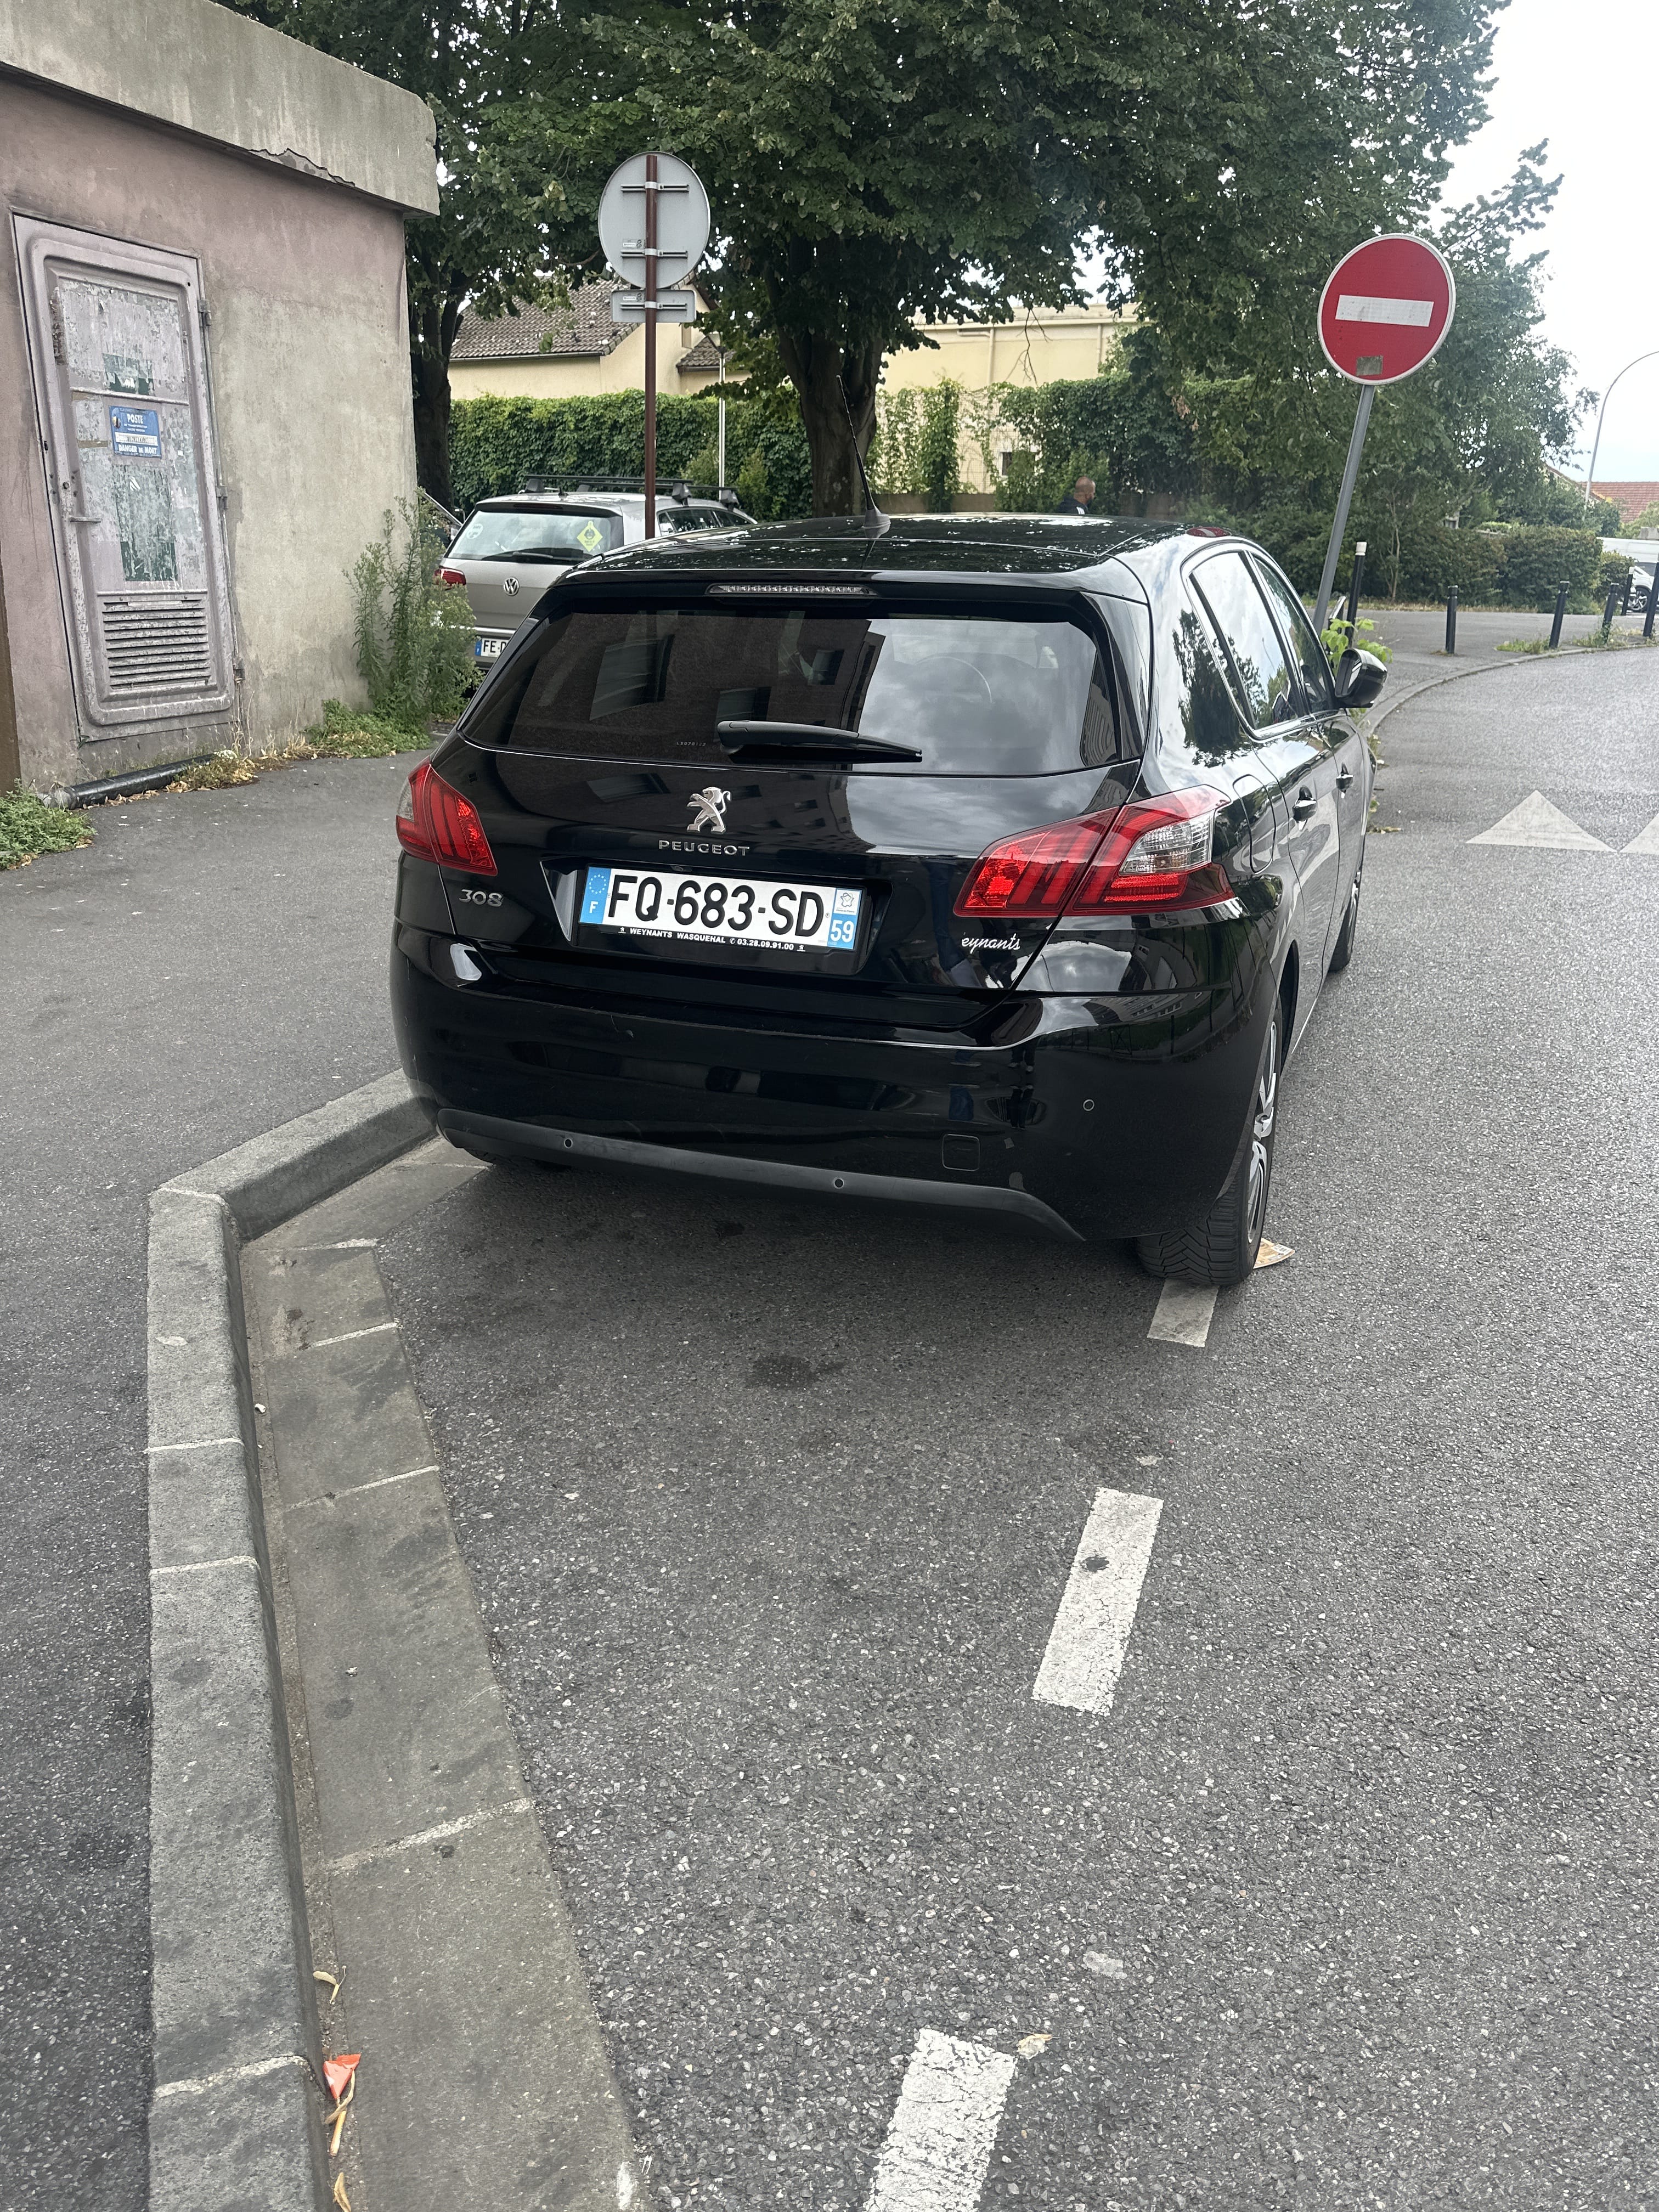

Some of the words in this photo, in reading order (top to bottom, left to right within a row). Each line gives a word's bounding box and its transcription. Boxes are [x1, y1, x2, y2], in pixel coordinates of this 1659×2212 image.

[127, 413, 144, 424] POSTE
[118, 444, 138, 453] DANGER
[144, 446, 157, 454] MORT
[658, 839, 750, 856] PEUGEOT
[459, 889, 502, 907] 308
[589, 901, 599, 913] F
[608, 874, 824, 937] FQ-683-SD
[630, 928, 673, 938] WEYNANTS
[677, 933, 726, 944] WASQUEHAL
[737, 938, 794, 950] 03.28.09.91.00
[830, 919, 854, 943] 59
[961, 932, 1020, 954] eynants
